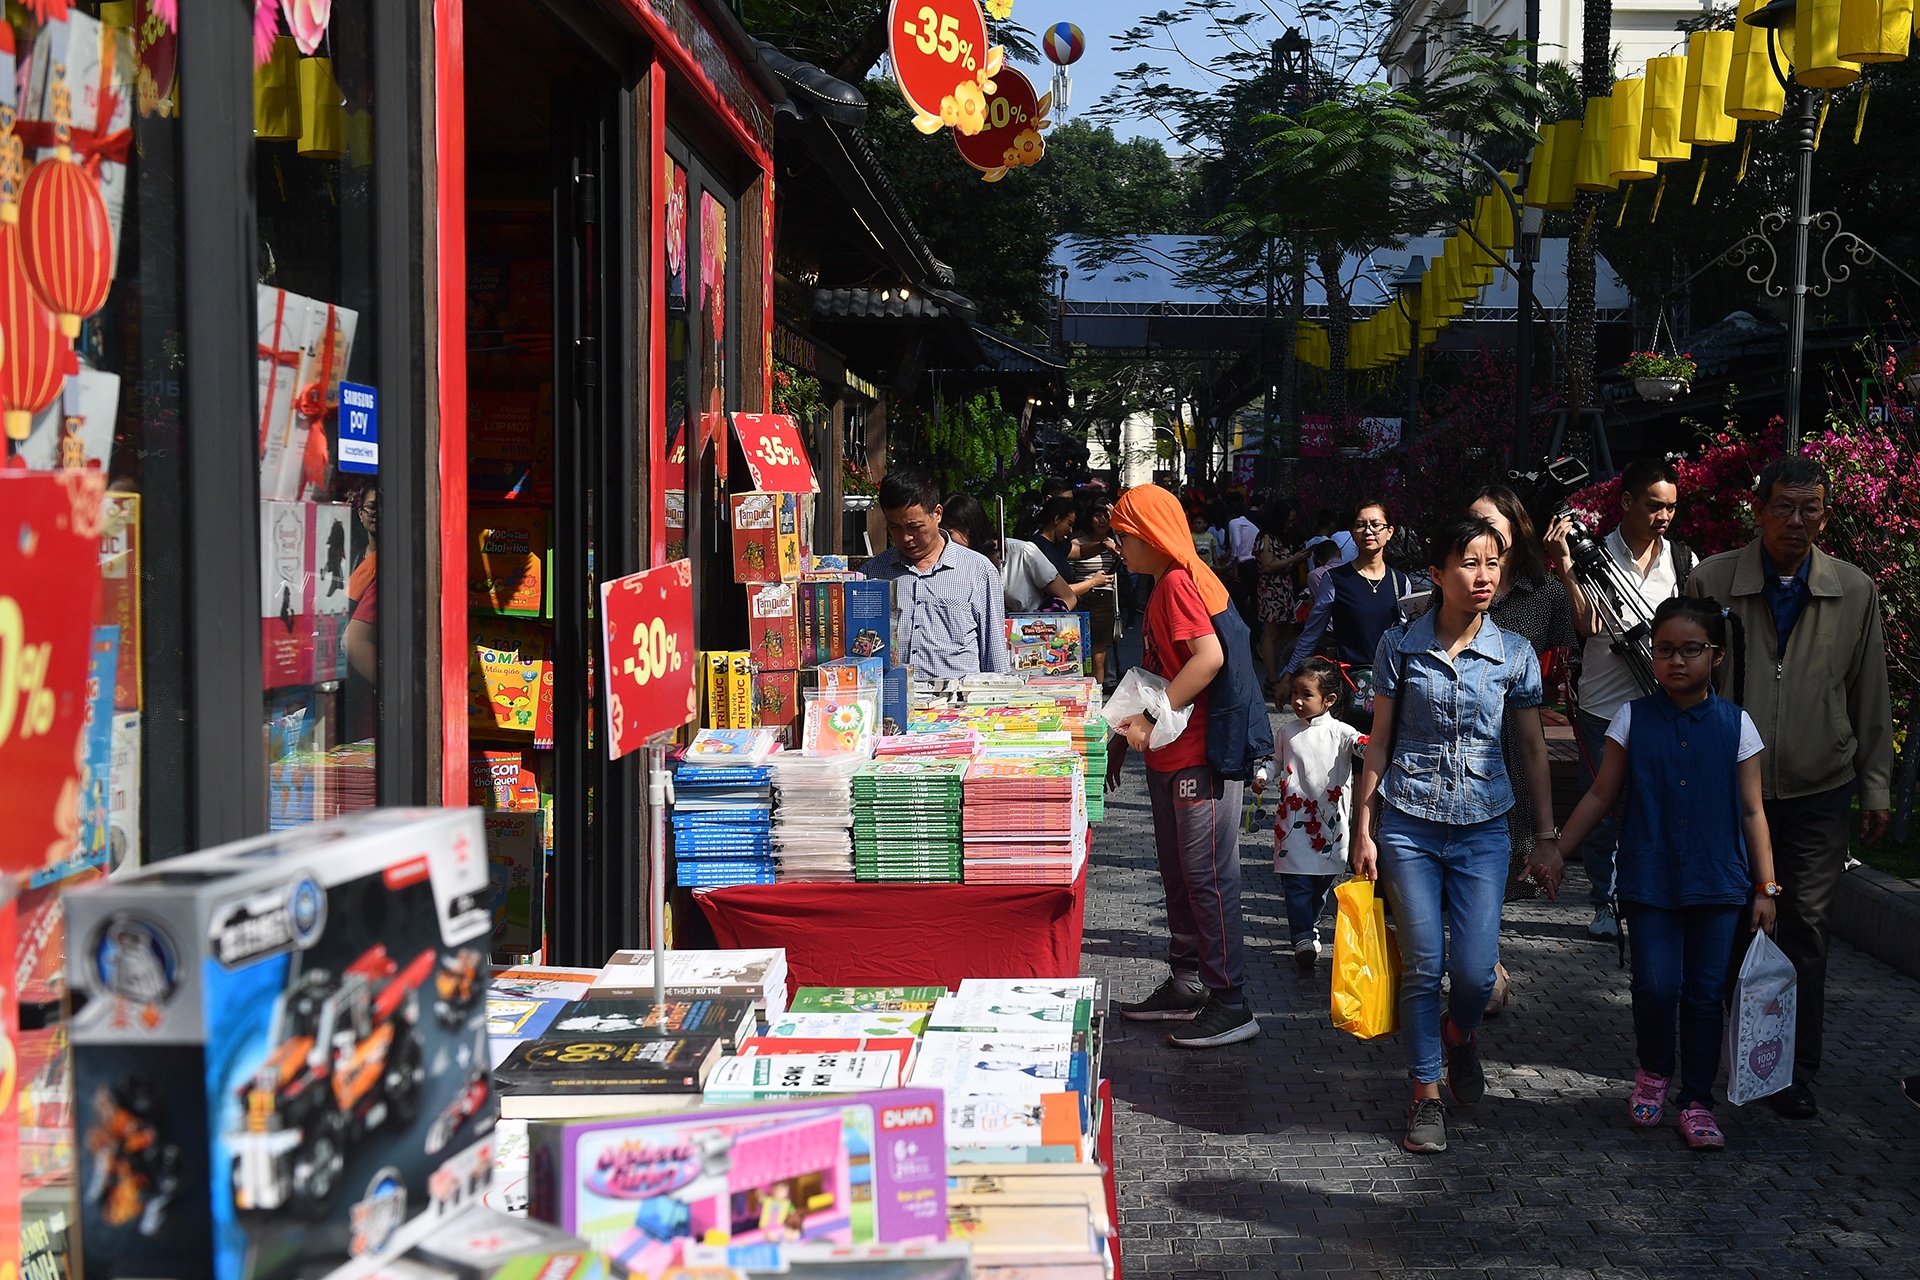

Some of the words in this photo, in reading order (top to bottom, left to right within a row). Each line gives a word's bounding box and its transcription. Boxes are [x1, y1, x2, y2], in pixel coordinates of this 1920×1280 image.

[904, 6, 976, 71] -35%
[343, 389, 374, 409] SAMSUNG
[350, 410, 368, 435] pay
[755, 436, 800, 466] -35%
[485, 541, 506, 553] Chơi
[513, 542, 528, 553] Học
[624, 617, 681, 686] -30%
[736, 679, 746, 711] THỨC
[738, 712, 747, 730] TRI
[491, 764, 519, 776] con
[1179, 778, 1197, 798] 82
[673, 987, 695, 997] THUẬT
[695, 985, 707, 995] XỬ
[707, 985, 721, 995] THẾ
[1757, 1051, 1776, 1064] 1000
[883, 1107, 933, 1129] DUKA
[893, 1139, 918, 1161] 6+
